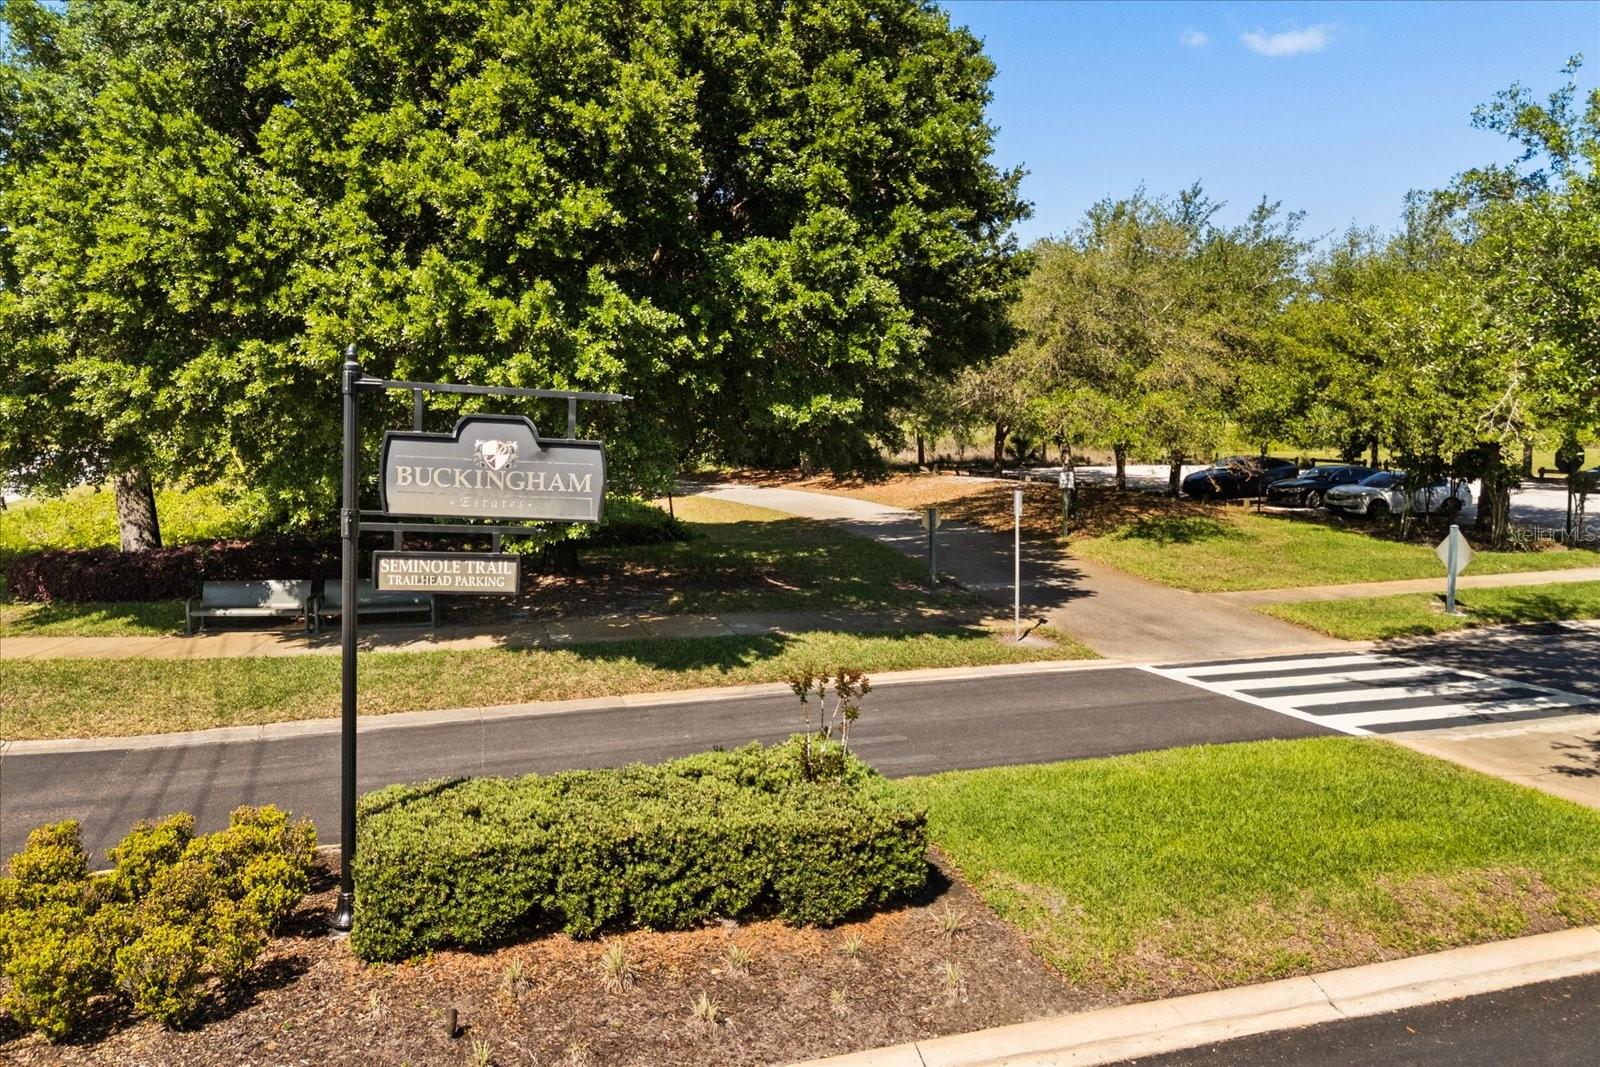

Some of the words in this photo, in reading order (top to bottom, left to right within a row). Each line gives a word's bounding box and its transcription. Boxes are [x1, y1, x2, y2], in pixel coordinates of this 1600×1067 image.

[395, 466, 593, 493] BUCKINGHAM
[380, 558, 461, 575] SEMINOLE
[464, 560, 512, 576] TRAIL
[387, 575, 452, 587] TRAILHEAD
[454, 576, 505, 588] PARKING
